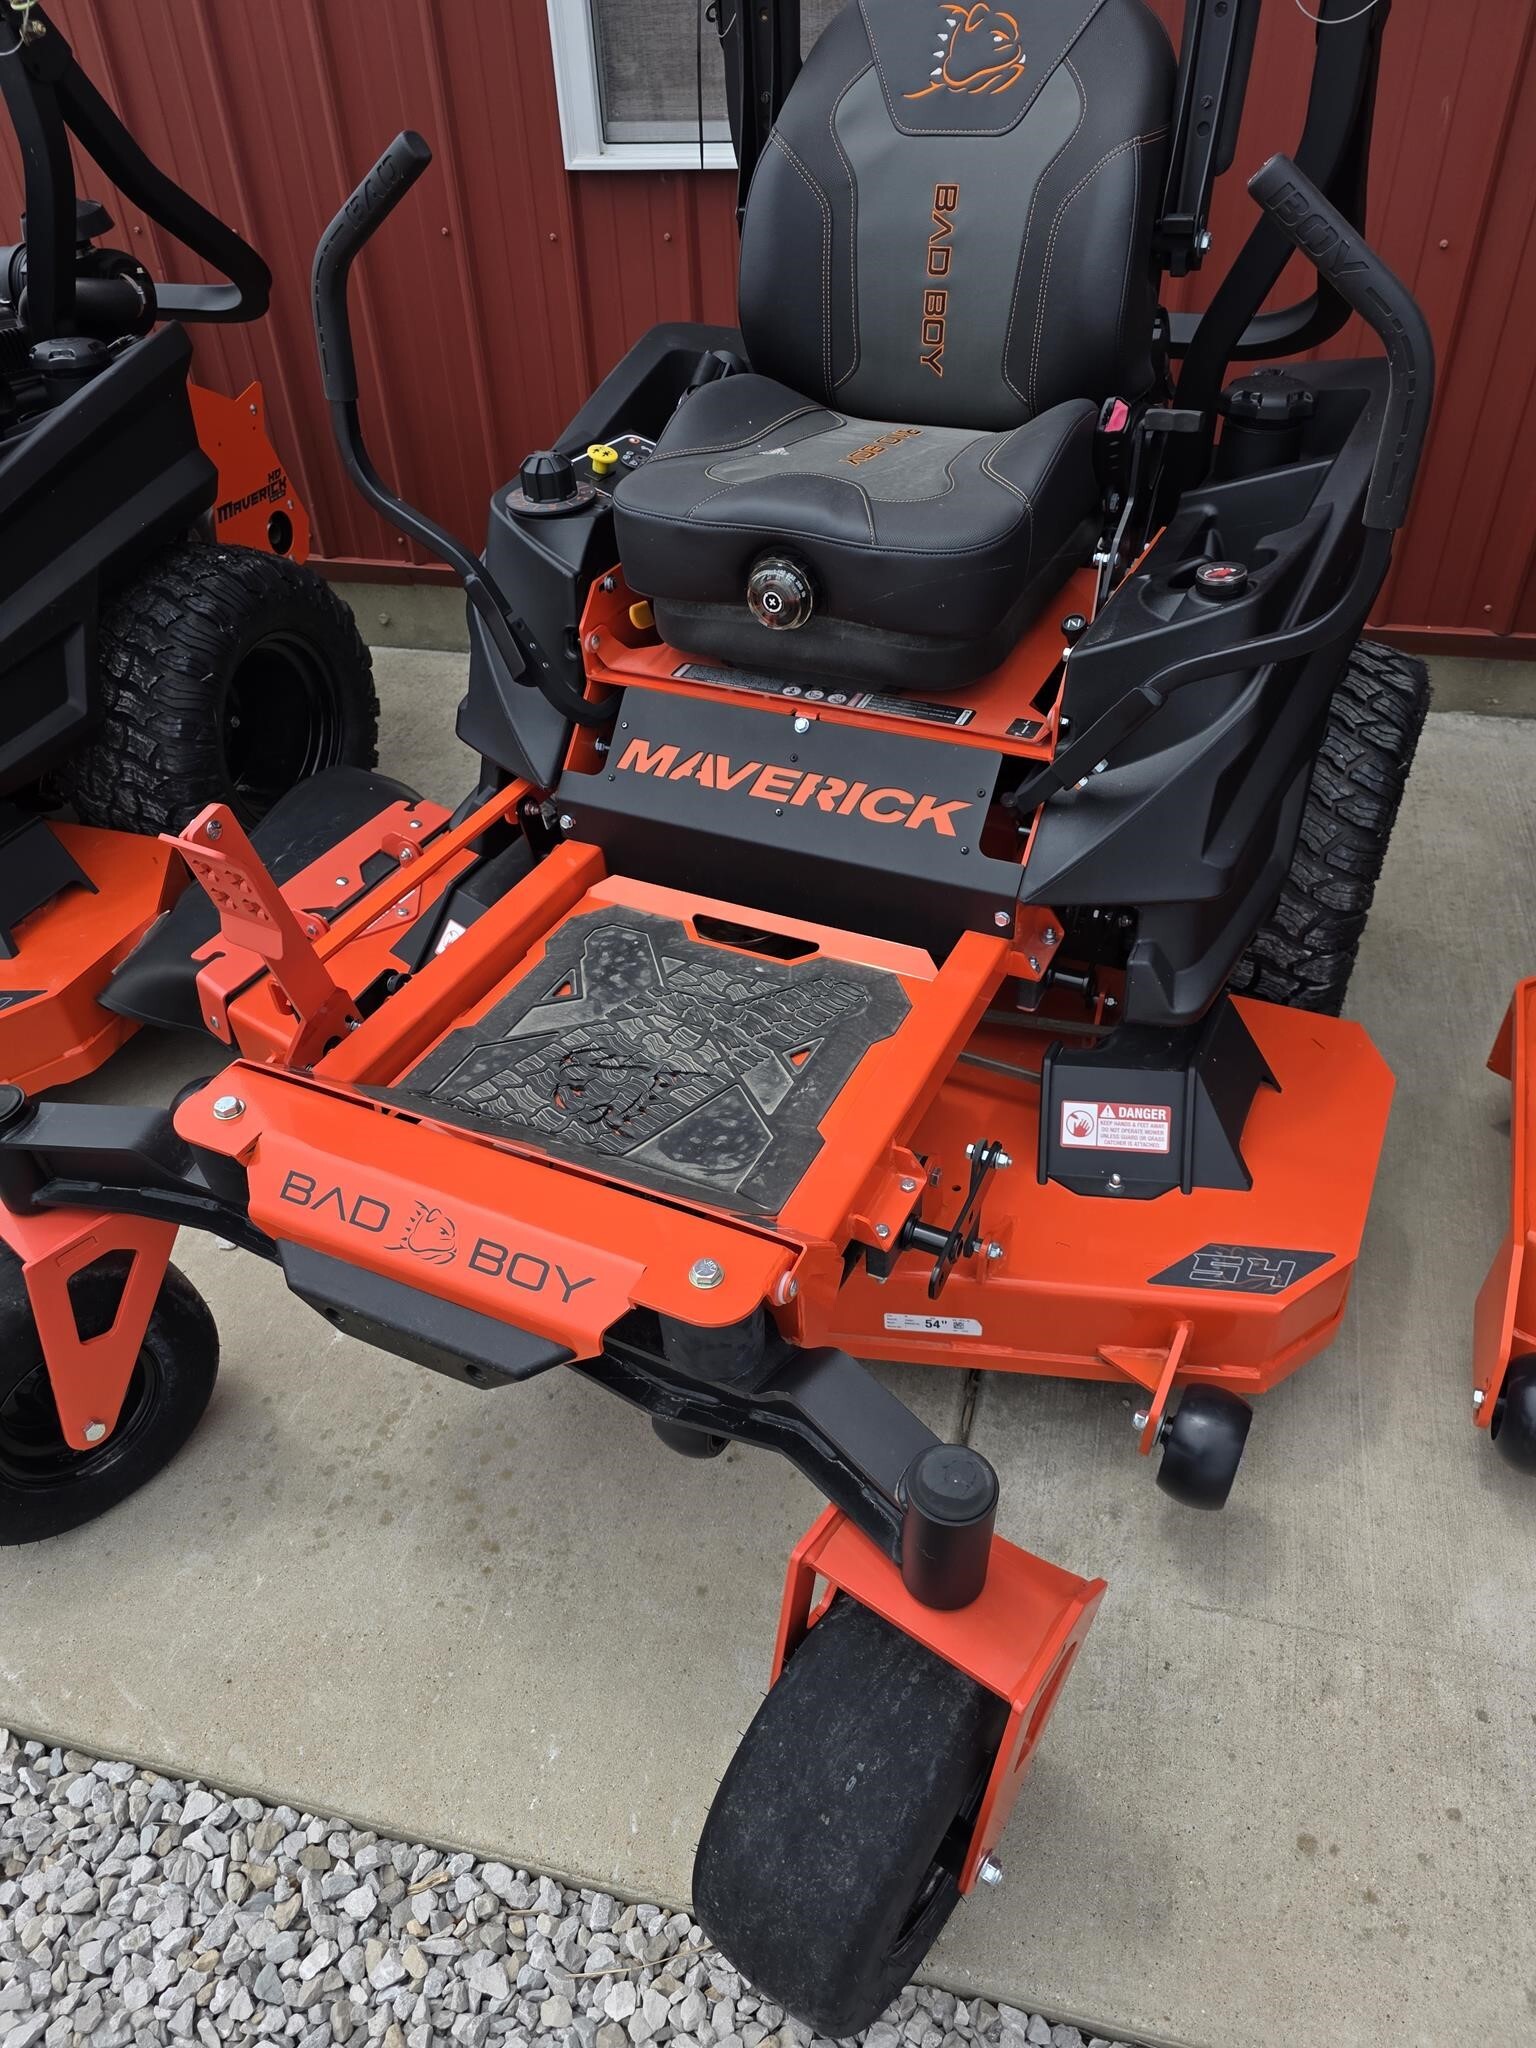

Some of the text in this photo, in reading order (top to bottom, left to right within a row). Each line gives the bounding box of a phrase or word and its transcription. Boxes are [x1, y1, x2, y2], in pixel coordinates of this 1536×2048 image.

[1265, 181, 1370, 278] BOY
[920, 183, 960, 377] BAD BOY
[217, 475, 287, 524] MAVERICK
[267, 467, 282, 484] HD
[616, 737, 974, 837] MAVERICK
[1118, 1106, 1167, 1121] DANGER
[280, 1170, 597, 1303] BAD BOY
[1189, 1253, 1296, 1288] 54
[924, 1319, 948, 1329] 54"
